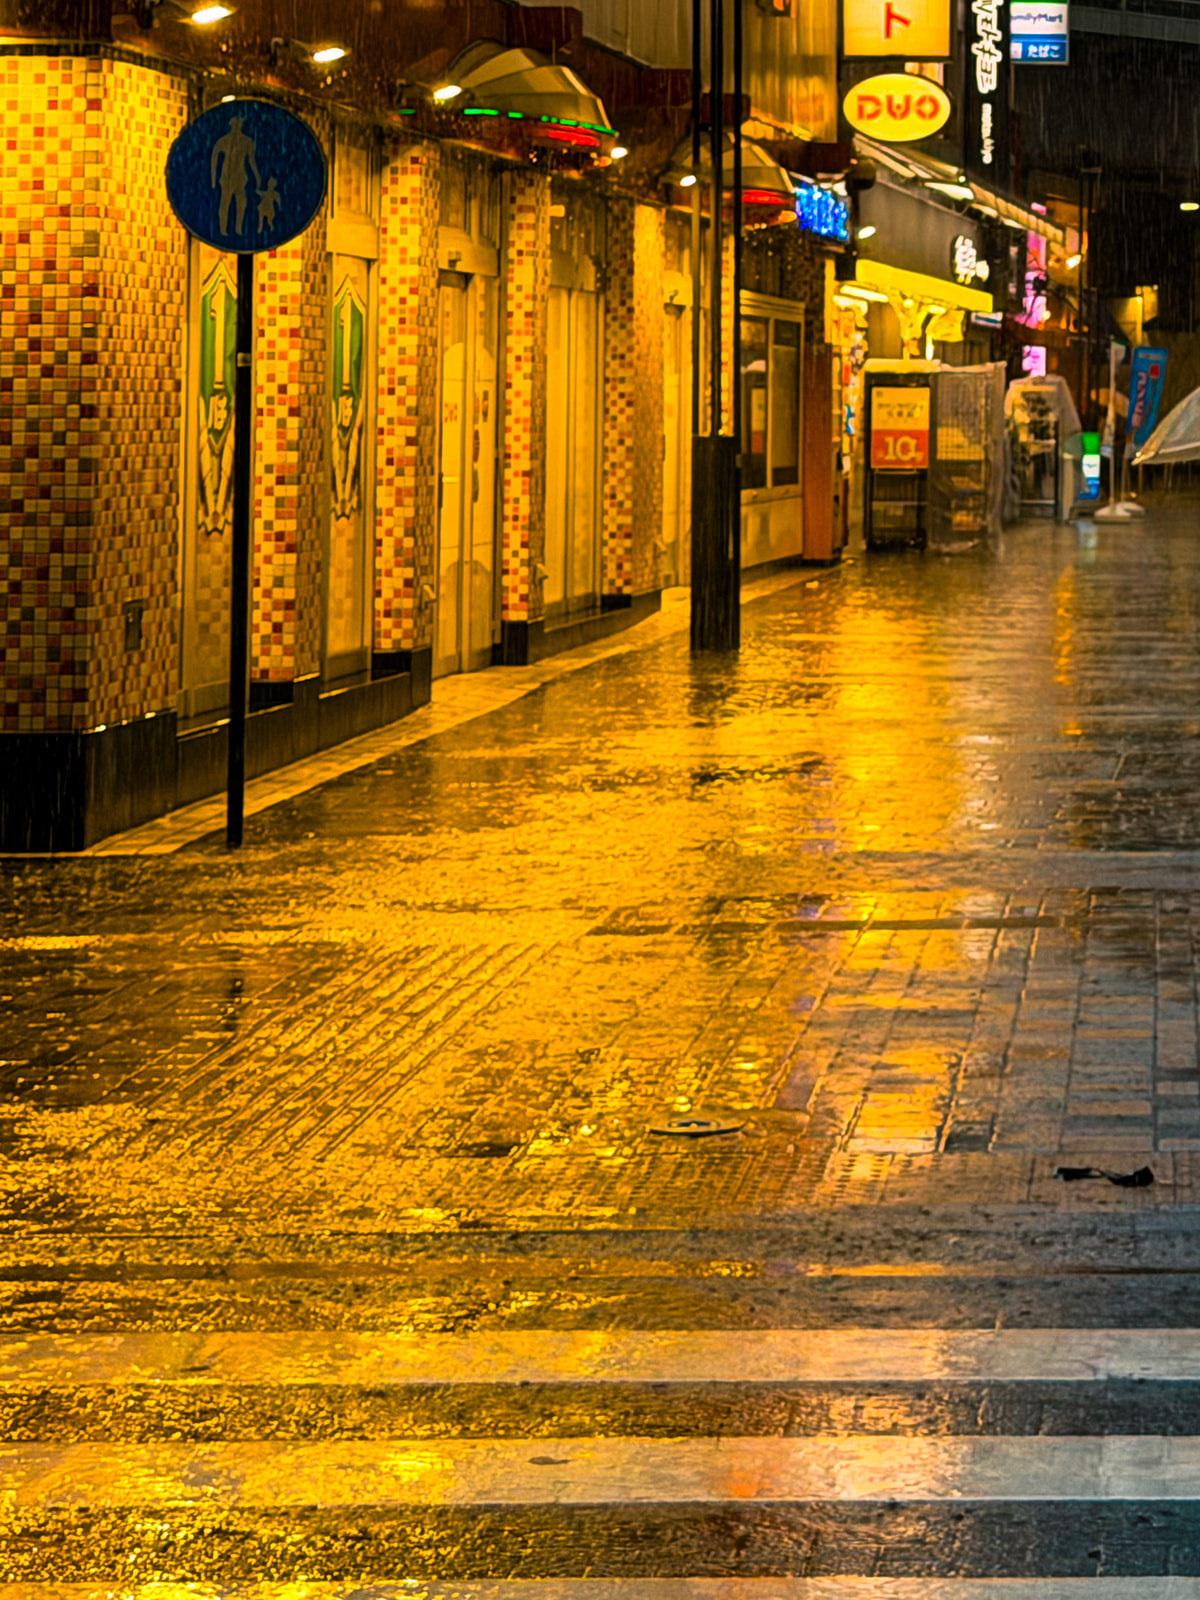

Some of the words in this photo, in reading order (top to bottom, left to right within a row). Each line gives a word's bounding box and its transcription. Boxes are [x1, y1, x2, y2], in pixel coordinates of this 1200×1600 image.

[1027, 44, 1061, 59] たばこ
[856, 93, 941, 122] DUO
